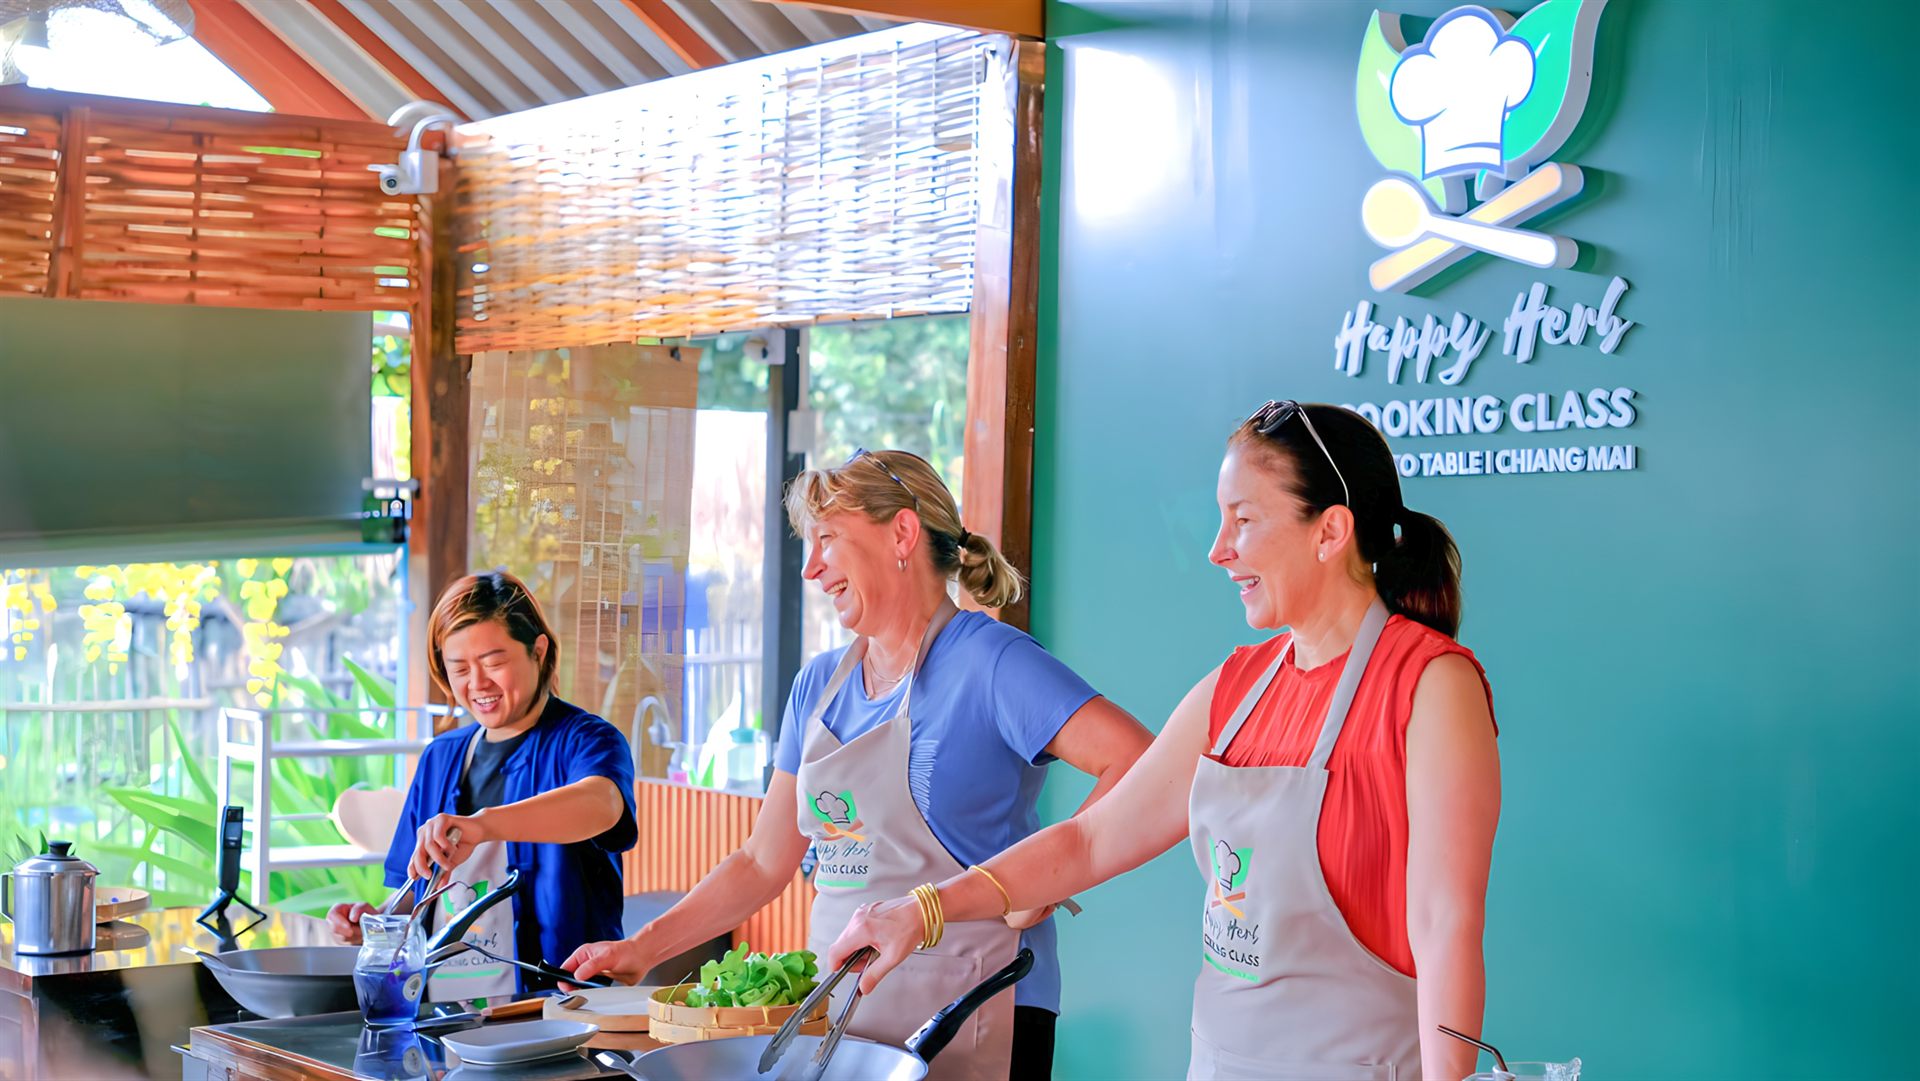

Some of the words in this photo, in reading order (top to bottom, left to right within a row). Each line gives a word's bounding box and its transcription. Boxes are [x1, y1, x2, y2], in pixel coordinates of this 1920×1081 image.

[1334, 300, 1493, 386] Happy
[1503, 276, 1636, 364] Herb
[1340, 394, 1504, 437] OOKING
[1510, 387, 1637, 432] CLASS
[1420, 450, 1482, 476] TABLE
[1495, 447, 1587, 474] CHIANG
[1588, 445, 1637, 471] MAI
[839, 864, 868, 875] CLASS
[1227, 918, 1259, 945] Herb
[1229, 949, 1260, 967] CLASS
